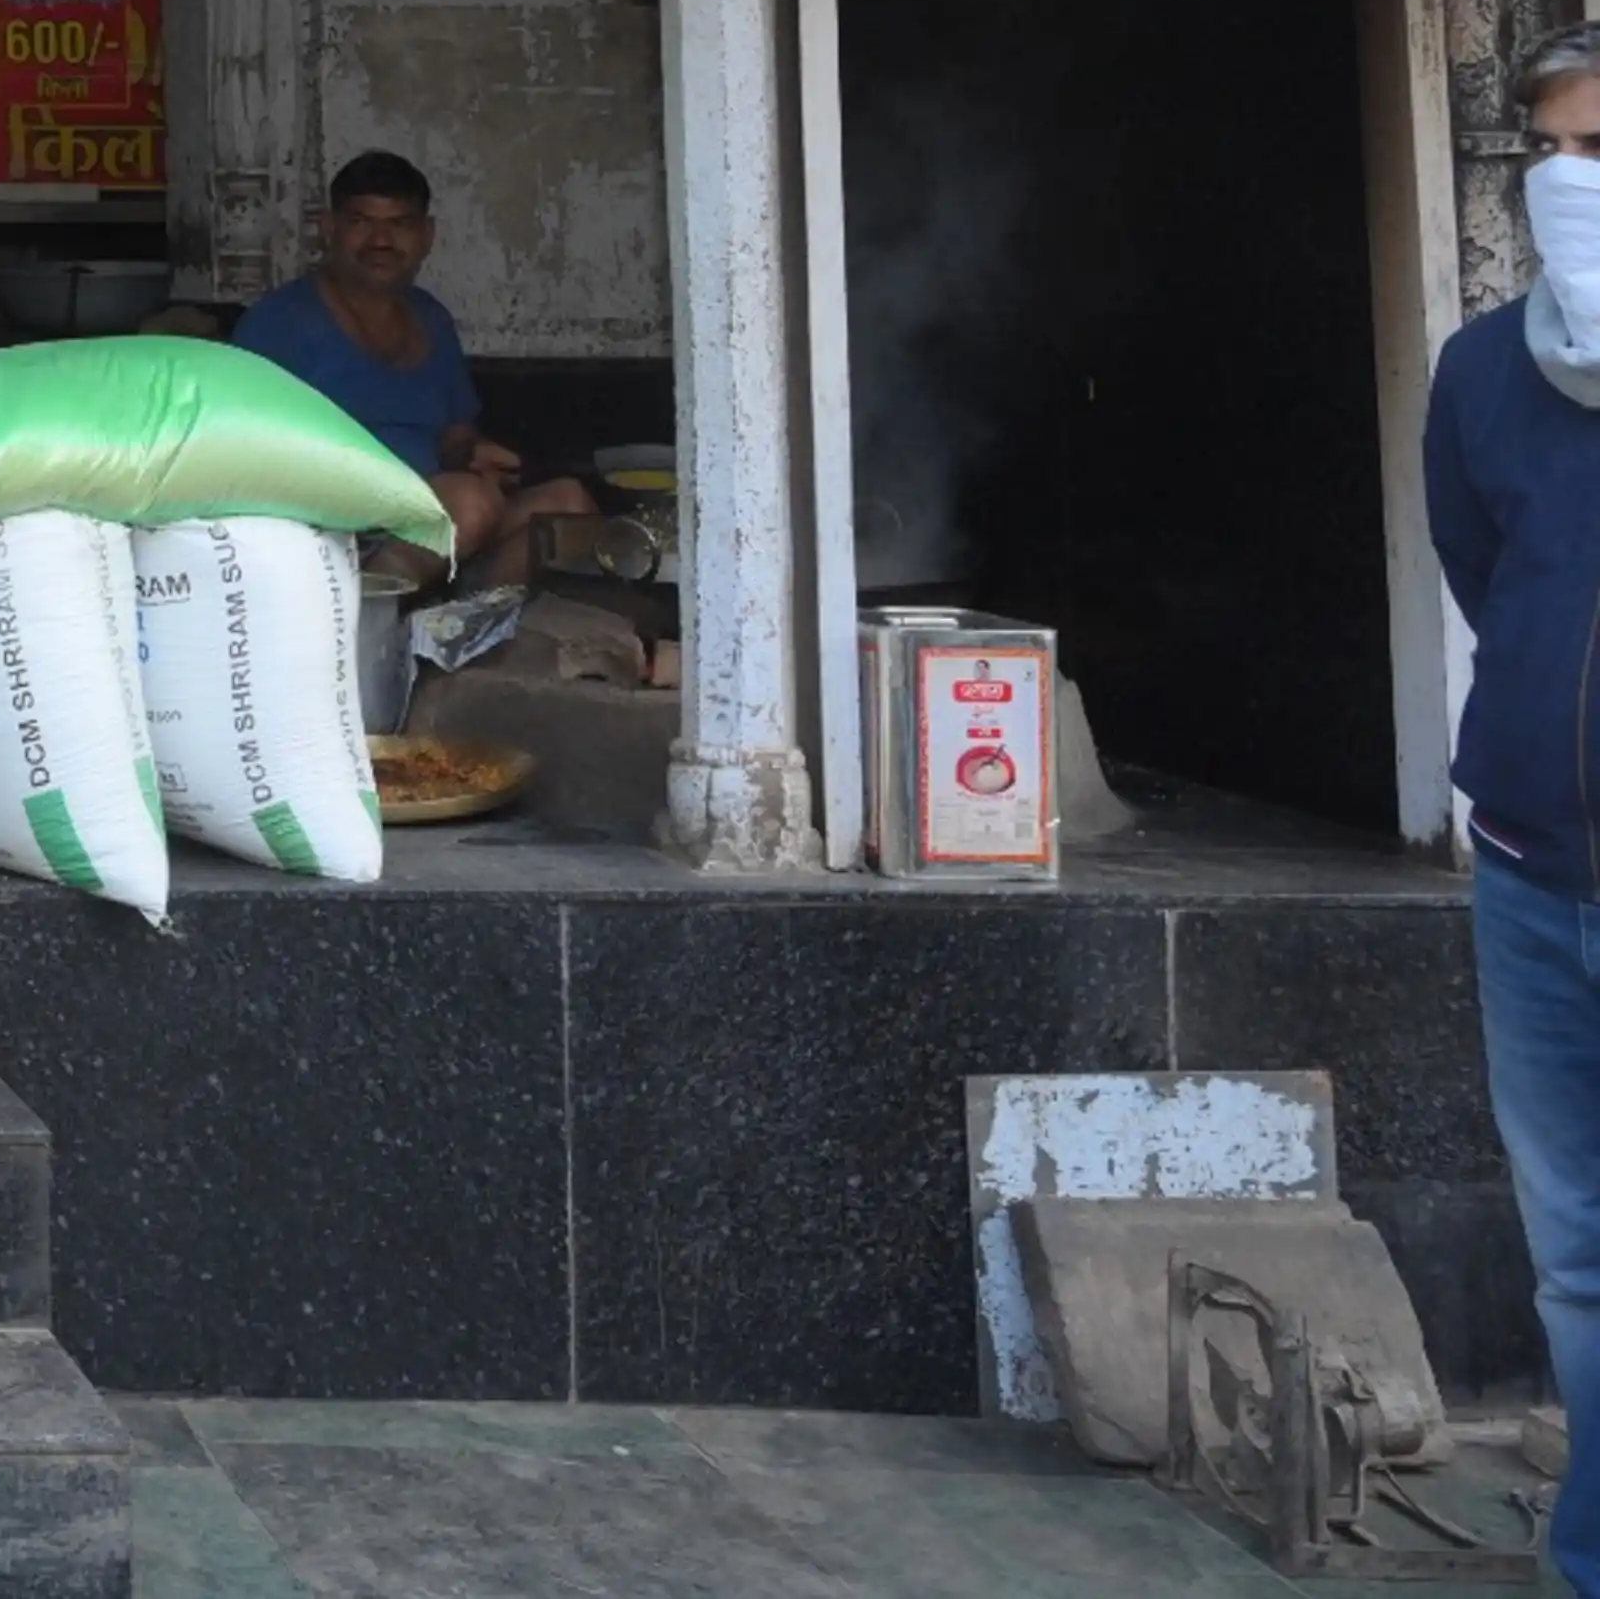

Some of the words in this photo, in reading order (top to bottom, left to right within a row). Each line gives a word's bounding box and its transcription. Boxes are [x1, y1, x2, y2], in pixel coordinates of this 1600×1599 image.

[6, 19, 120, 67] 600/-
[224, 590, 256, 733] SHRIRAM
[19, 720, 51, 789] DCM
[238, 738, 273, 803] DCM
